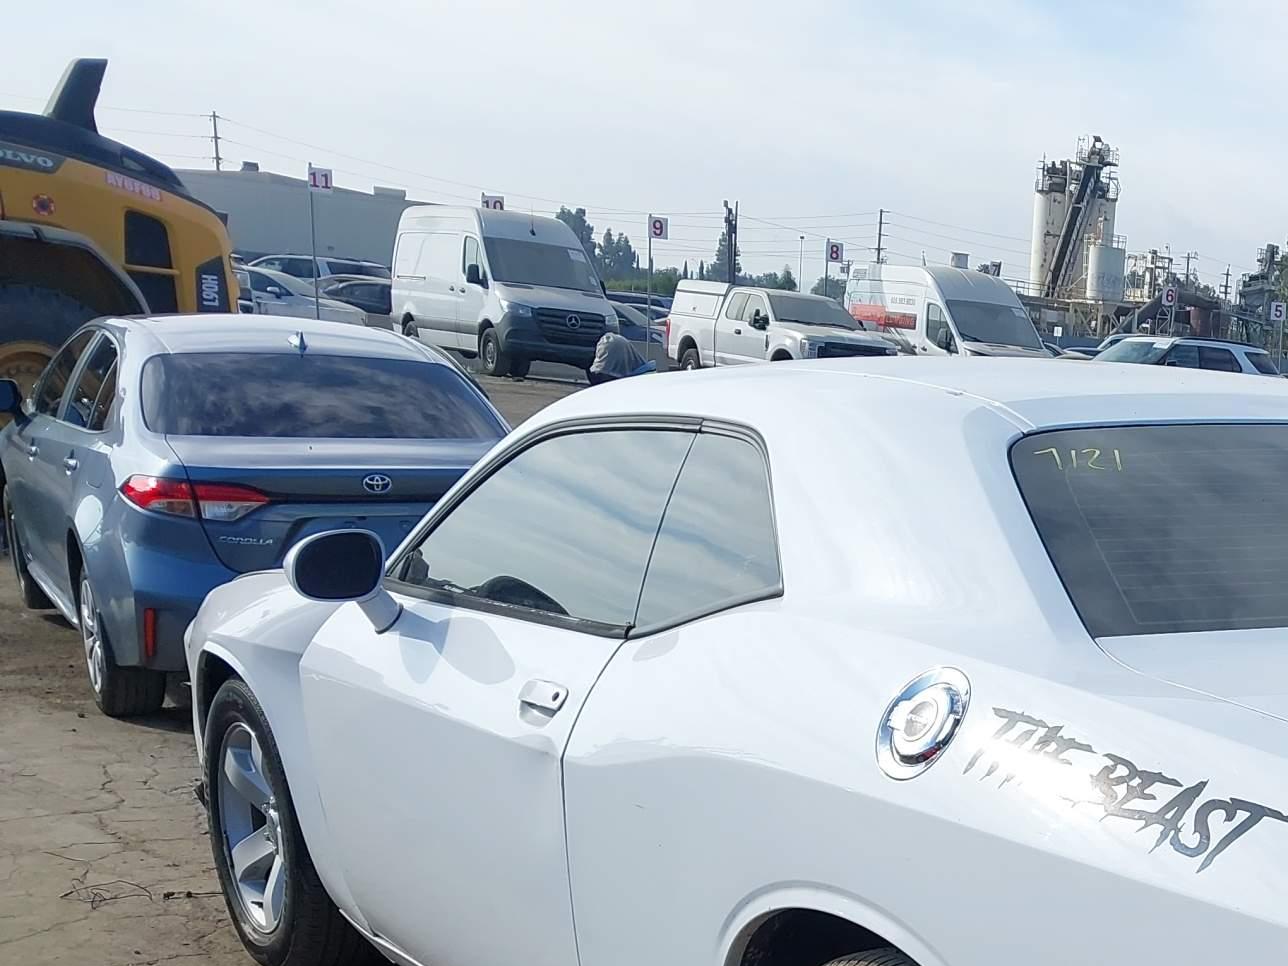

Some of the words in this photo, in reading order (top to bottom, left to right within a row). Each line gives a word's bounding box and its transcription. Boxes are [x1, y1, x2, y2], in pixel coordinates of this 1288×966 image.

[0, 151, 54, 168] LVO
[309, 171, 331, 189] 11
[652, 219, 664, 237] 9
[830, 244, 839, 260] 8
[202, 274, 219, 306] L90H
[1165, 288, 1174, 303] 6
[1274, 304, 1282, 318] 5
[1033, 447, 1122, 471] 7121
